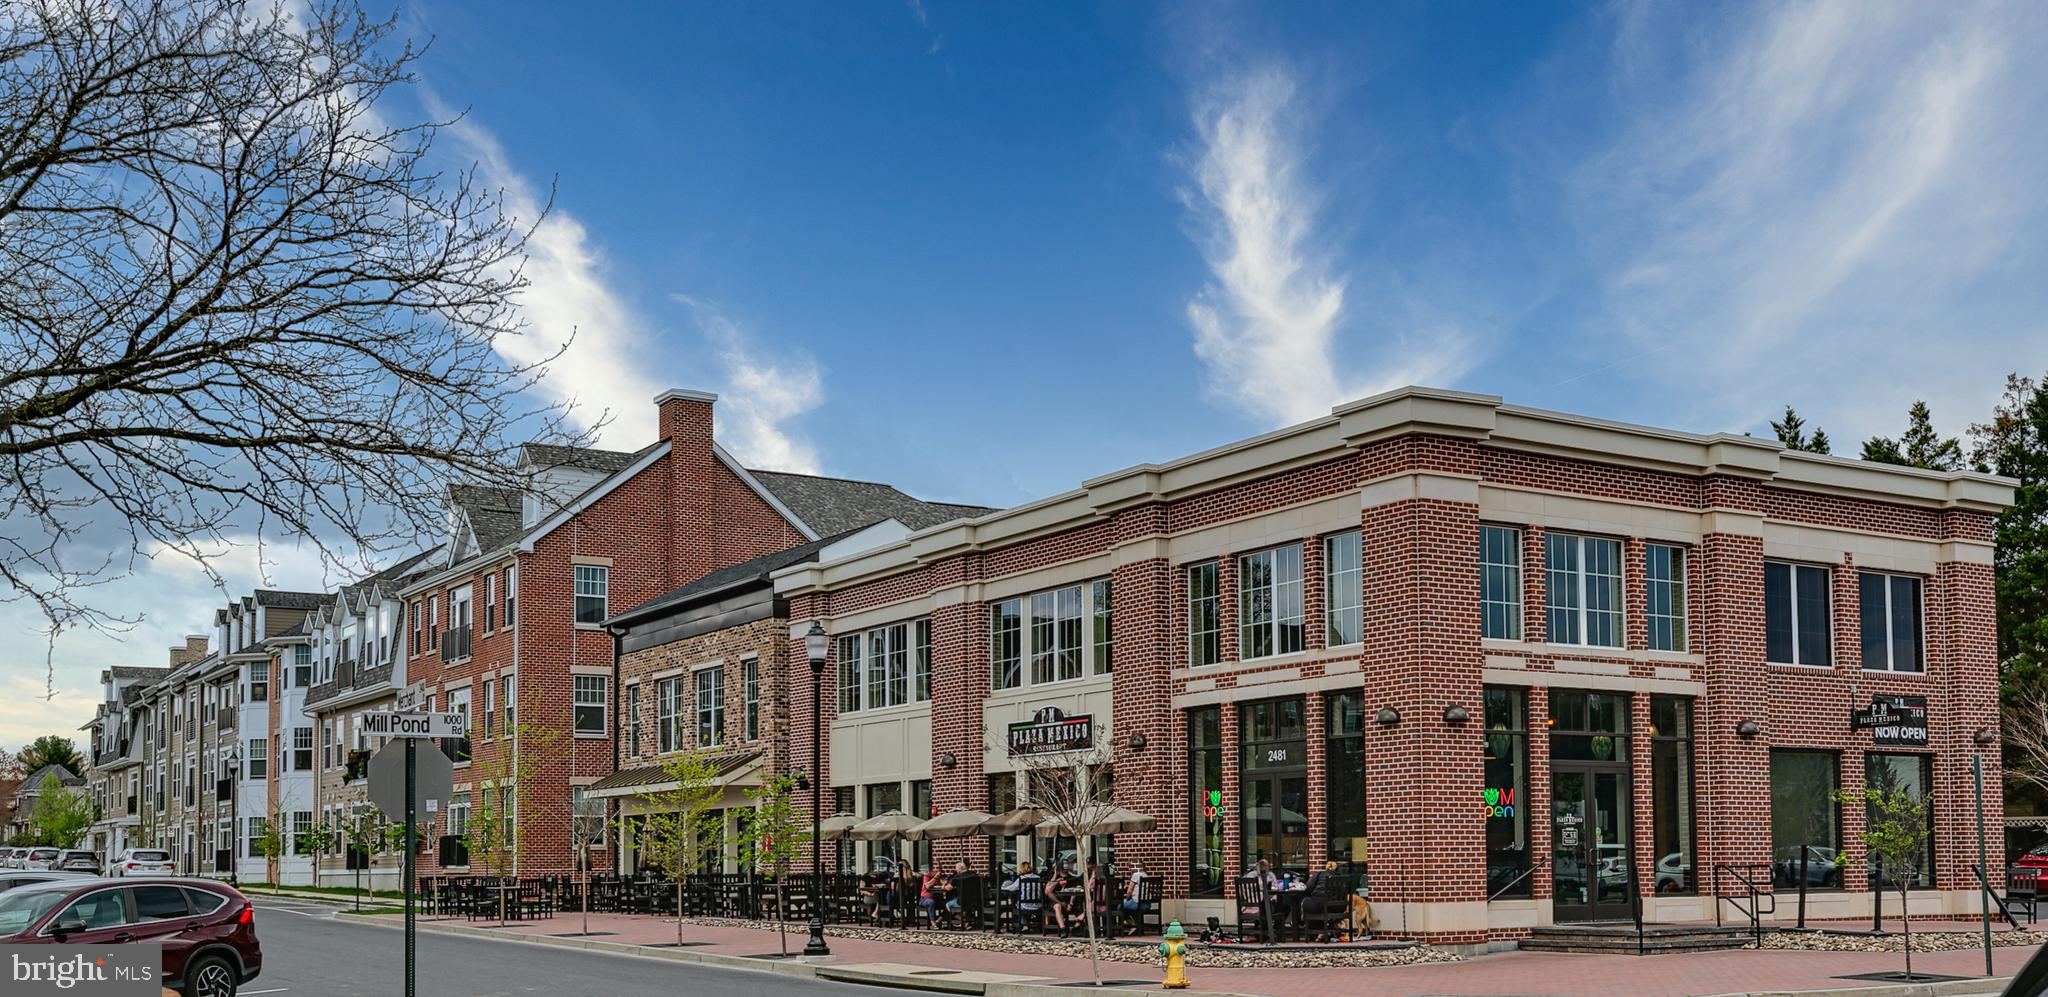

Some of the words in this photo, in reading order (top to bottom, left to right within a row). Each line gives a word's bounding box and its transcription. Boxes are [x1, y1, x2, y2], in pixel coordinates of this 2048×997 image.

[1048, 708, 1055, 722] M
[1880, 703, 1888, 715] M
[363, 714, 387, 732] Mill
[391, 715, 430, 733] Pond
[443, 715, 462, 725] 1000
[452, 726, 462, 735] Rd
[1012, 728, 1044, 747] PLAZA
[1047, 723, 1088, 744] MEXICO
[1875, 727, 1900, 738] NOW
[1900, 727, 1927, 739] OPEN
[1267, 749, 1287, 761] 2481
[1500, 787, 1514, 806] M
[1202, 806, 1224, 822] ope
[1484, 805, 1514, 818] pen
